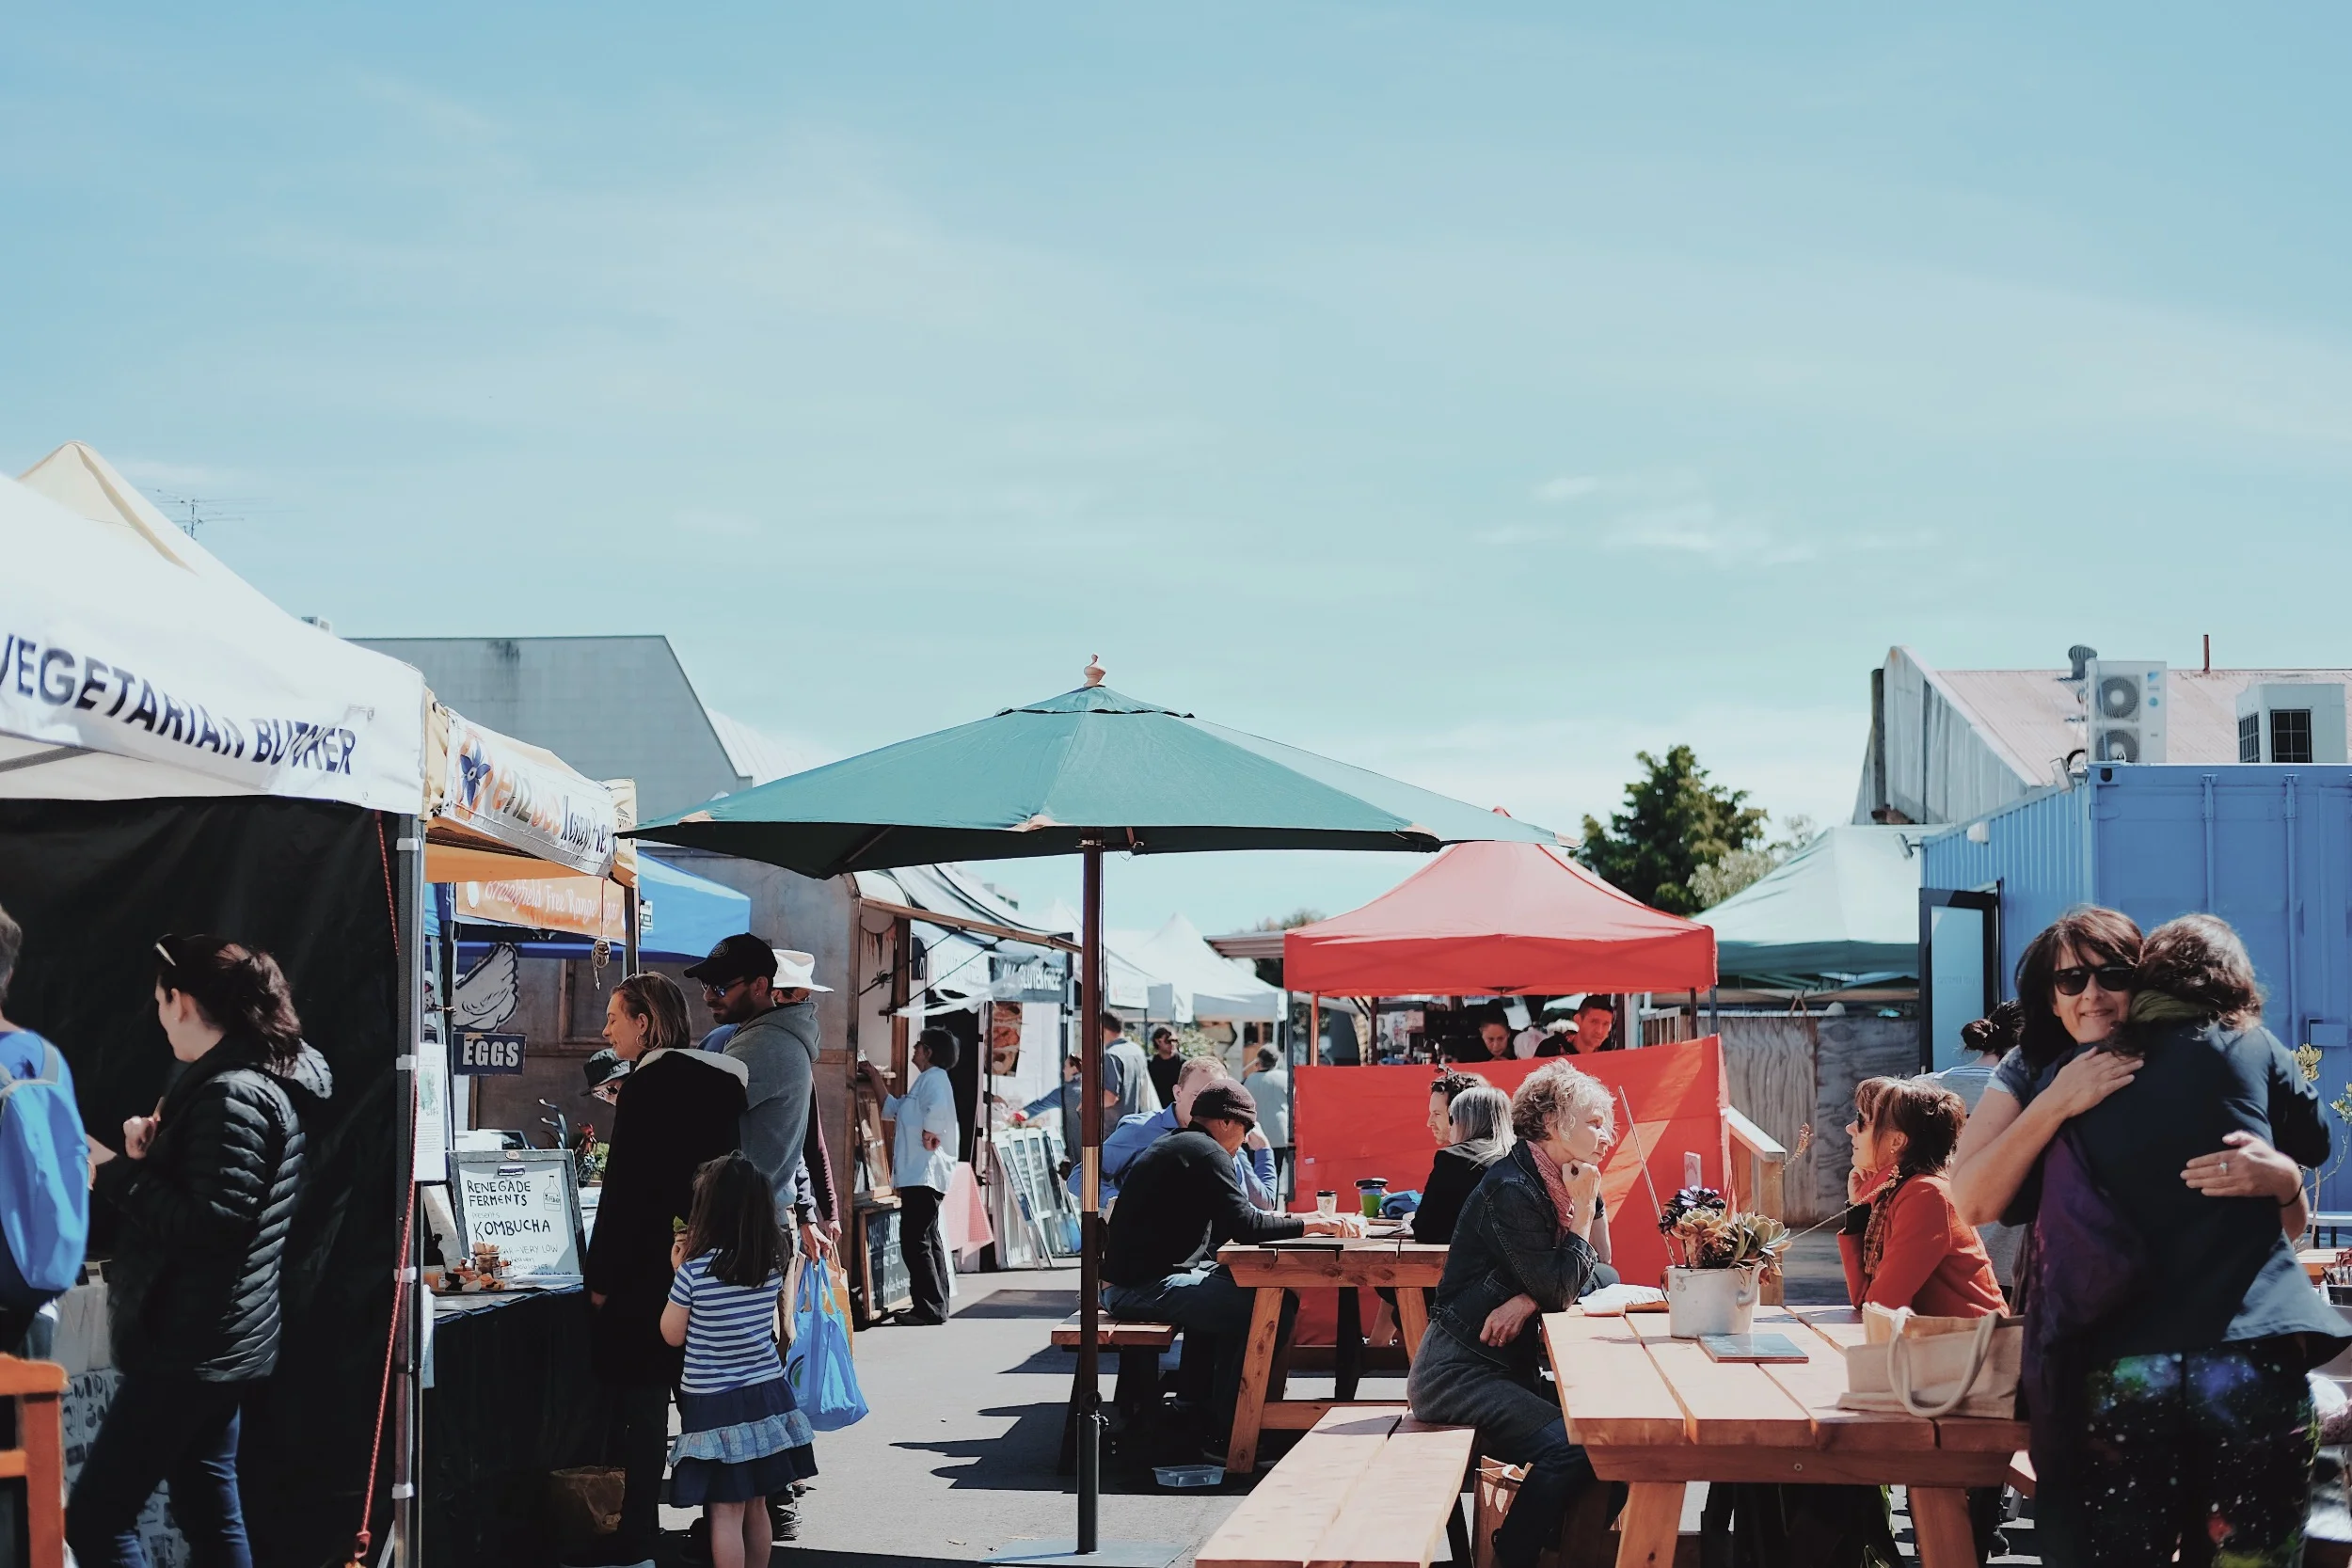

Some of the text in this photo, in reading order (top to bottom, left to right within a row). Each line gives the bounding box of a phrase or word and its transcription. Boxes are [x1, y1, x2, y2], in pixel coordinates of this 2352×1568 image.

[546, 885, 564, 912] Free
[568, 889, 596, 923] Range
[462, 1038, 519, 1068] EGGS
[467, 1180, 532, 1194] RENEGADE
[469, 1194, 528, 1207] FERMENTS
[473, 1219, 551, 1242] KOMBUCHA
[542, 1243, 559, 1253] LOW
